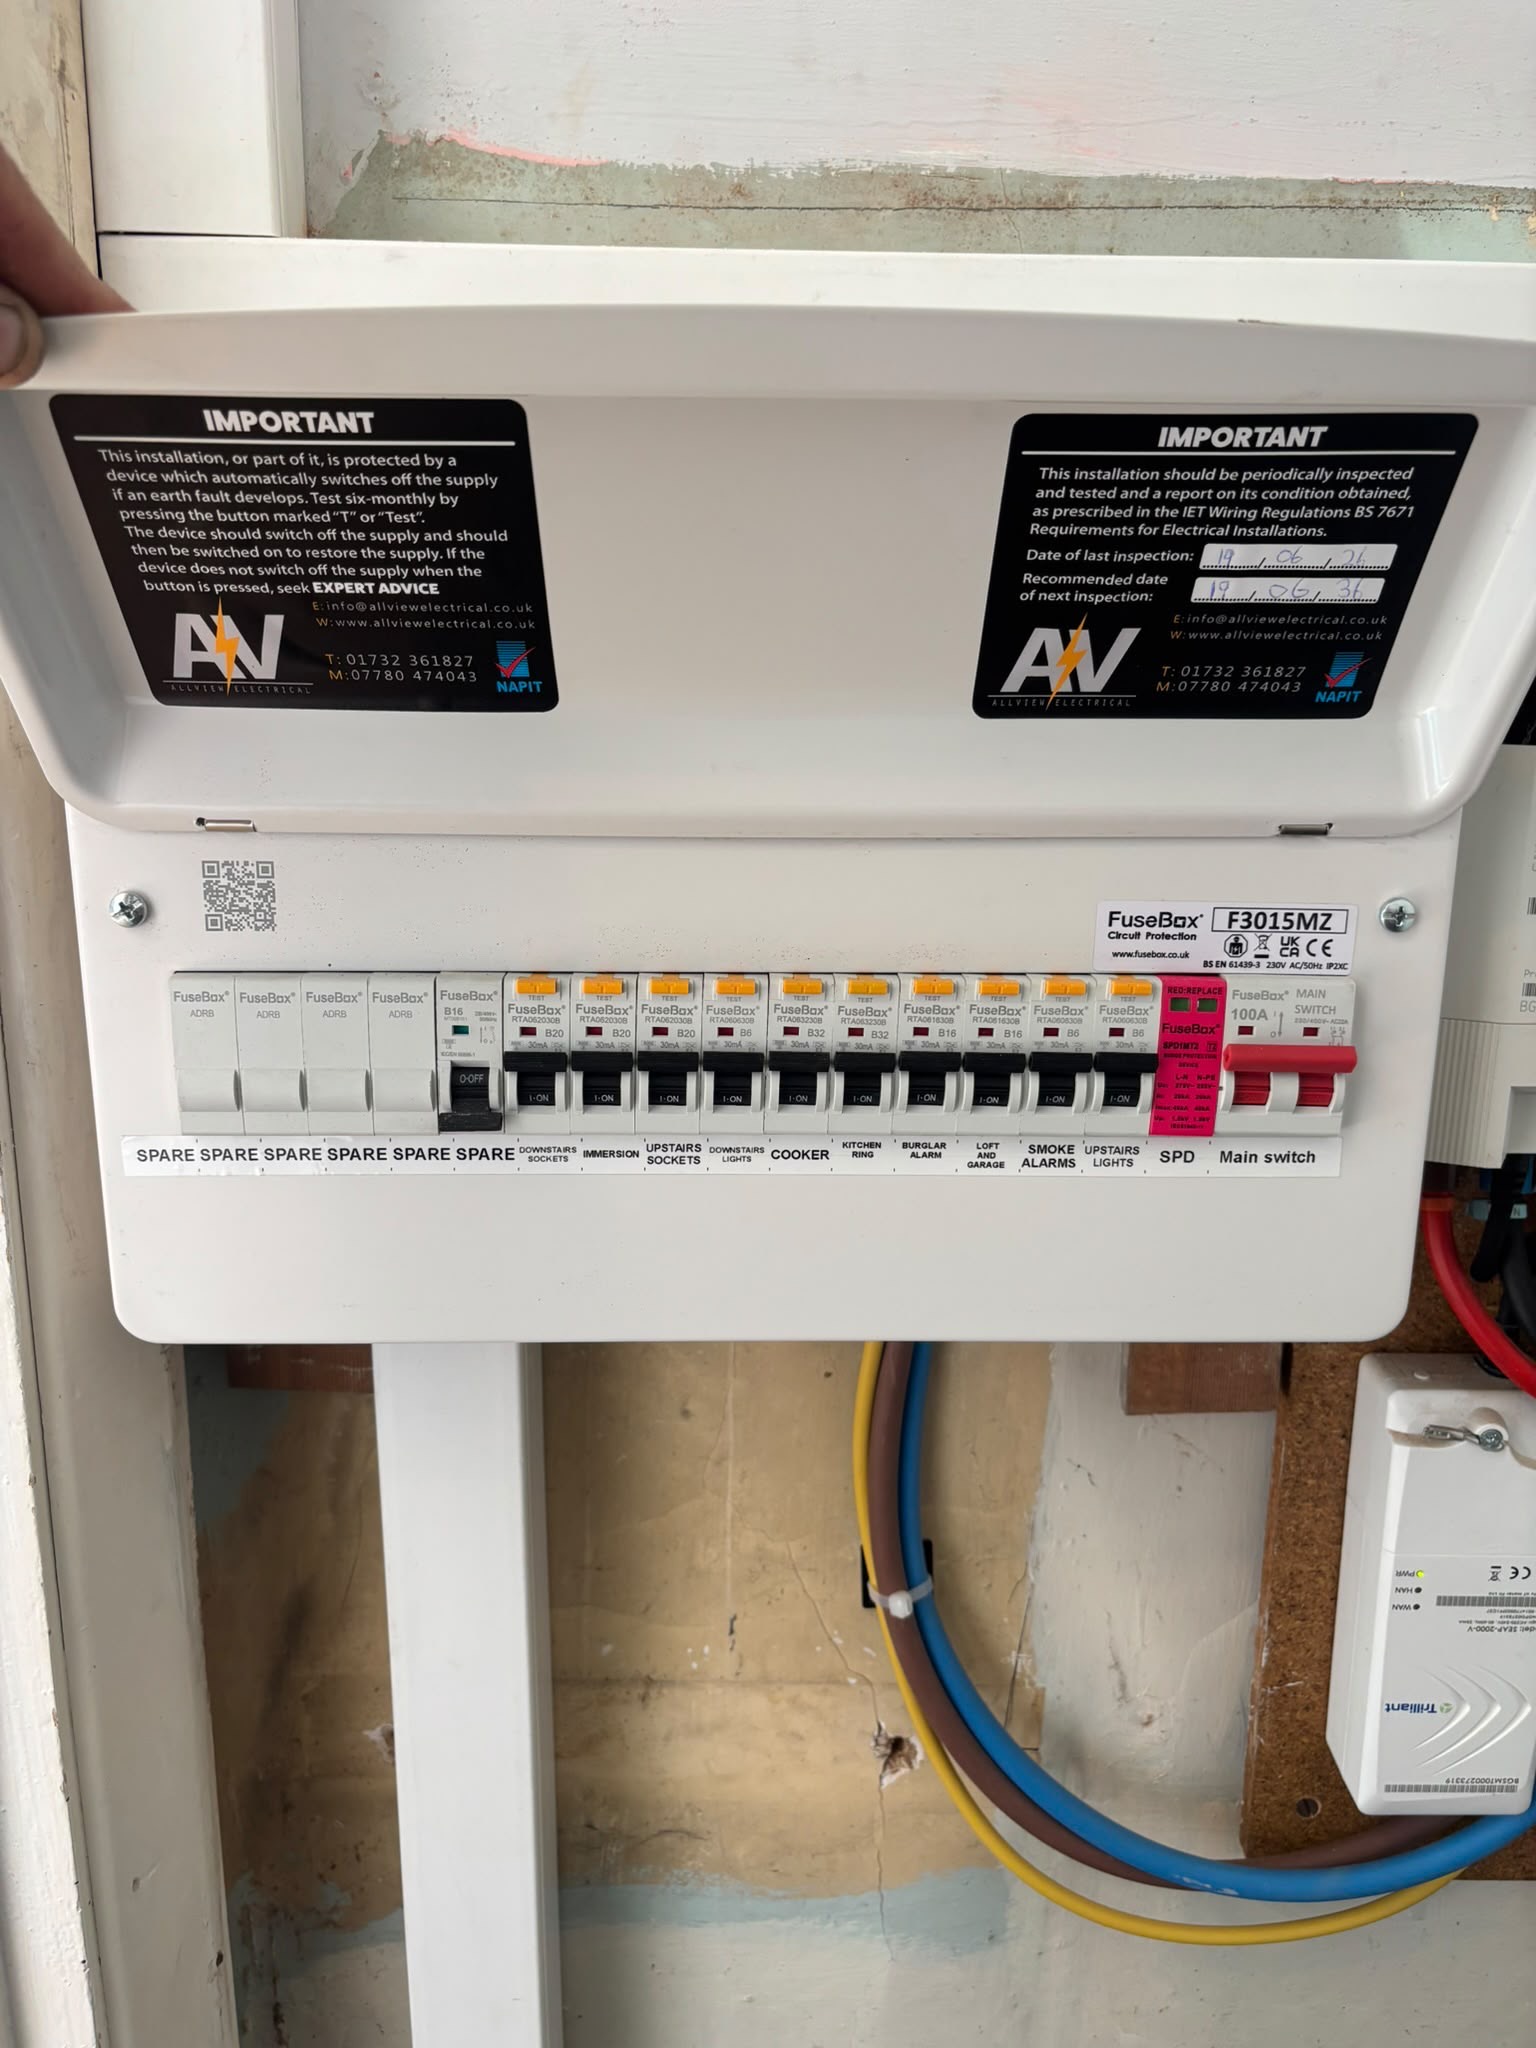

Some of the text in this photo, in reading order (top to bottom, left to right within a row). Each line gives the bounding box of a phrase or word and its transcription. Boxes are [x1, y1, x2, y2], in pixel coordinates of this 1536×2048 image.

[203, 410, 374, 433] IMPORTANT
[1158, 426, 1328, 448] IMPORTANT
[98, 449, 456, 469] This installation, or part of it, is protected by a
[106, 469, 498, 488] device which automatically switches off the supply
[1040, 467, 1414, 483] This installation should be periodically inspected
[120, 508, 185, 523] pressing
[188, 508, 213, 521] the
[216, 509, 269, 521] button
[274, 510, 330, 522] marked
[360, 514, 375, 522] or
[1032, 506, 1414, 521] as prescribed in the IET Wiring Regulations BS 7671
[1027, 549, 1194, 564] Date of last inspection:
[1023, 573, 1168, 585] Recommended date
[144, 580, 439, 594] button is pressed, seek EXPERT ADVICE
[1020, 590, 1153, 605] of next inspection:
[347, 654, 400, 666] 01732
[409, 655, 473, 667] 361827
[496, 682, 542, 692] NAPIT
[1238, 682, 1301, 692] 474043
[1315, 691, 1362, 702] NAPIT
[1228, 912, 1332, 931] F3015MZ
[1108, 932, 1196, 941] Circuit Protection
[1112, 950, 1189, 960] www.fusebox.co.uk
[1228, 961, 1260, 969] 61439-3
[1296, 989, 1326, 998] MAIN
[444, 1007, 463, 1016] B16
[1231, 1008, 1268, 1021] 100A
[1294, 1005, 1336, 1015] SWITCH
[545, 1029, 564, 1038] B20
[808, 1029, 825, 1037] B32
[583, 1150, 640, 1158] IMMERSION
[646, 1144, 702, 1153] UPSTAIRS
[1028, 1144, 1074, 1155] SMOKE
[1085, 1146, 1140, 1155] UPSTAIRS
[138, 1148, 515, 1162] SPARE SPARE SPARE SPARE SPARE SPARE
[647, 1155, 700, 1165] SOCKETS
[771, 1150, 829, 1160] COOKER
[1160, 1150, 1195, 1164] SPD
[1220, 1150, 1316, 1164] Main switch
[1022, 1158, 1076, 1168] ALARMS
[1093, 1158, 1133, 1167] LIGHTS
[1385, 1703, 1437, 1714] Trilliant
